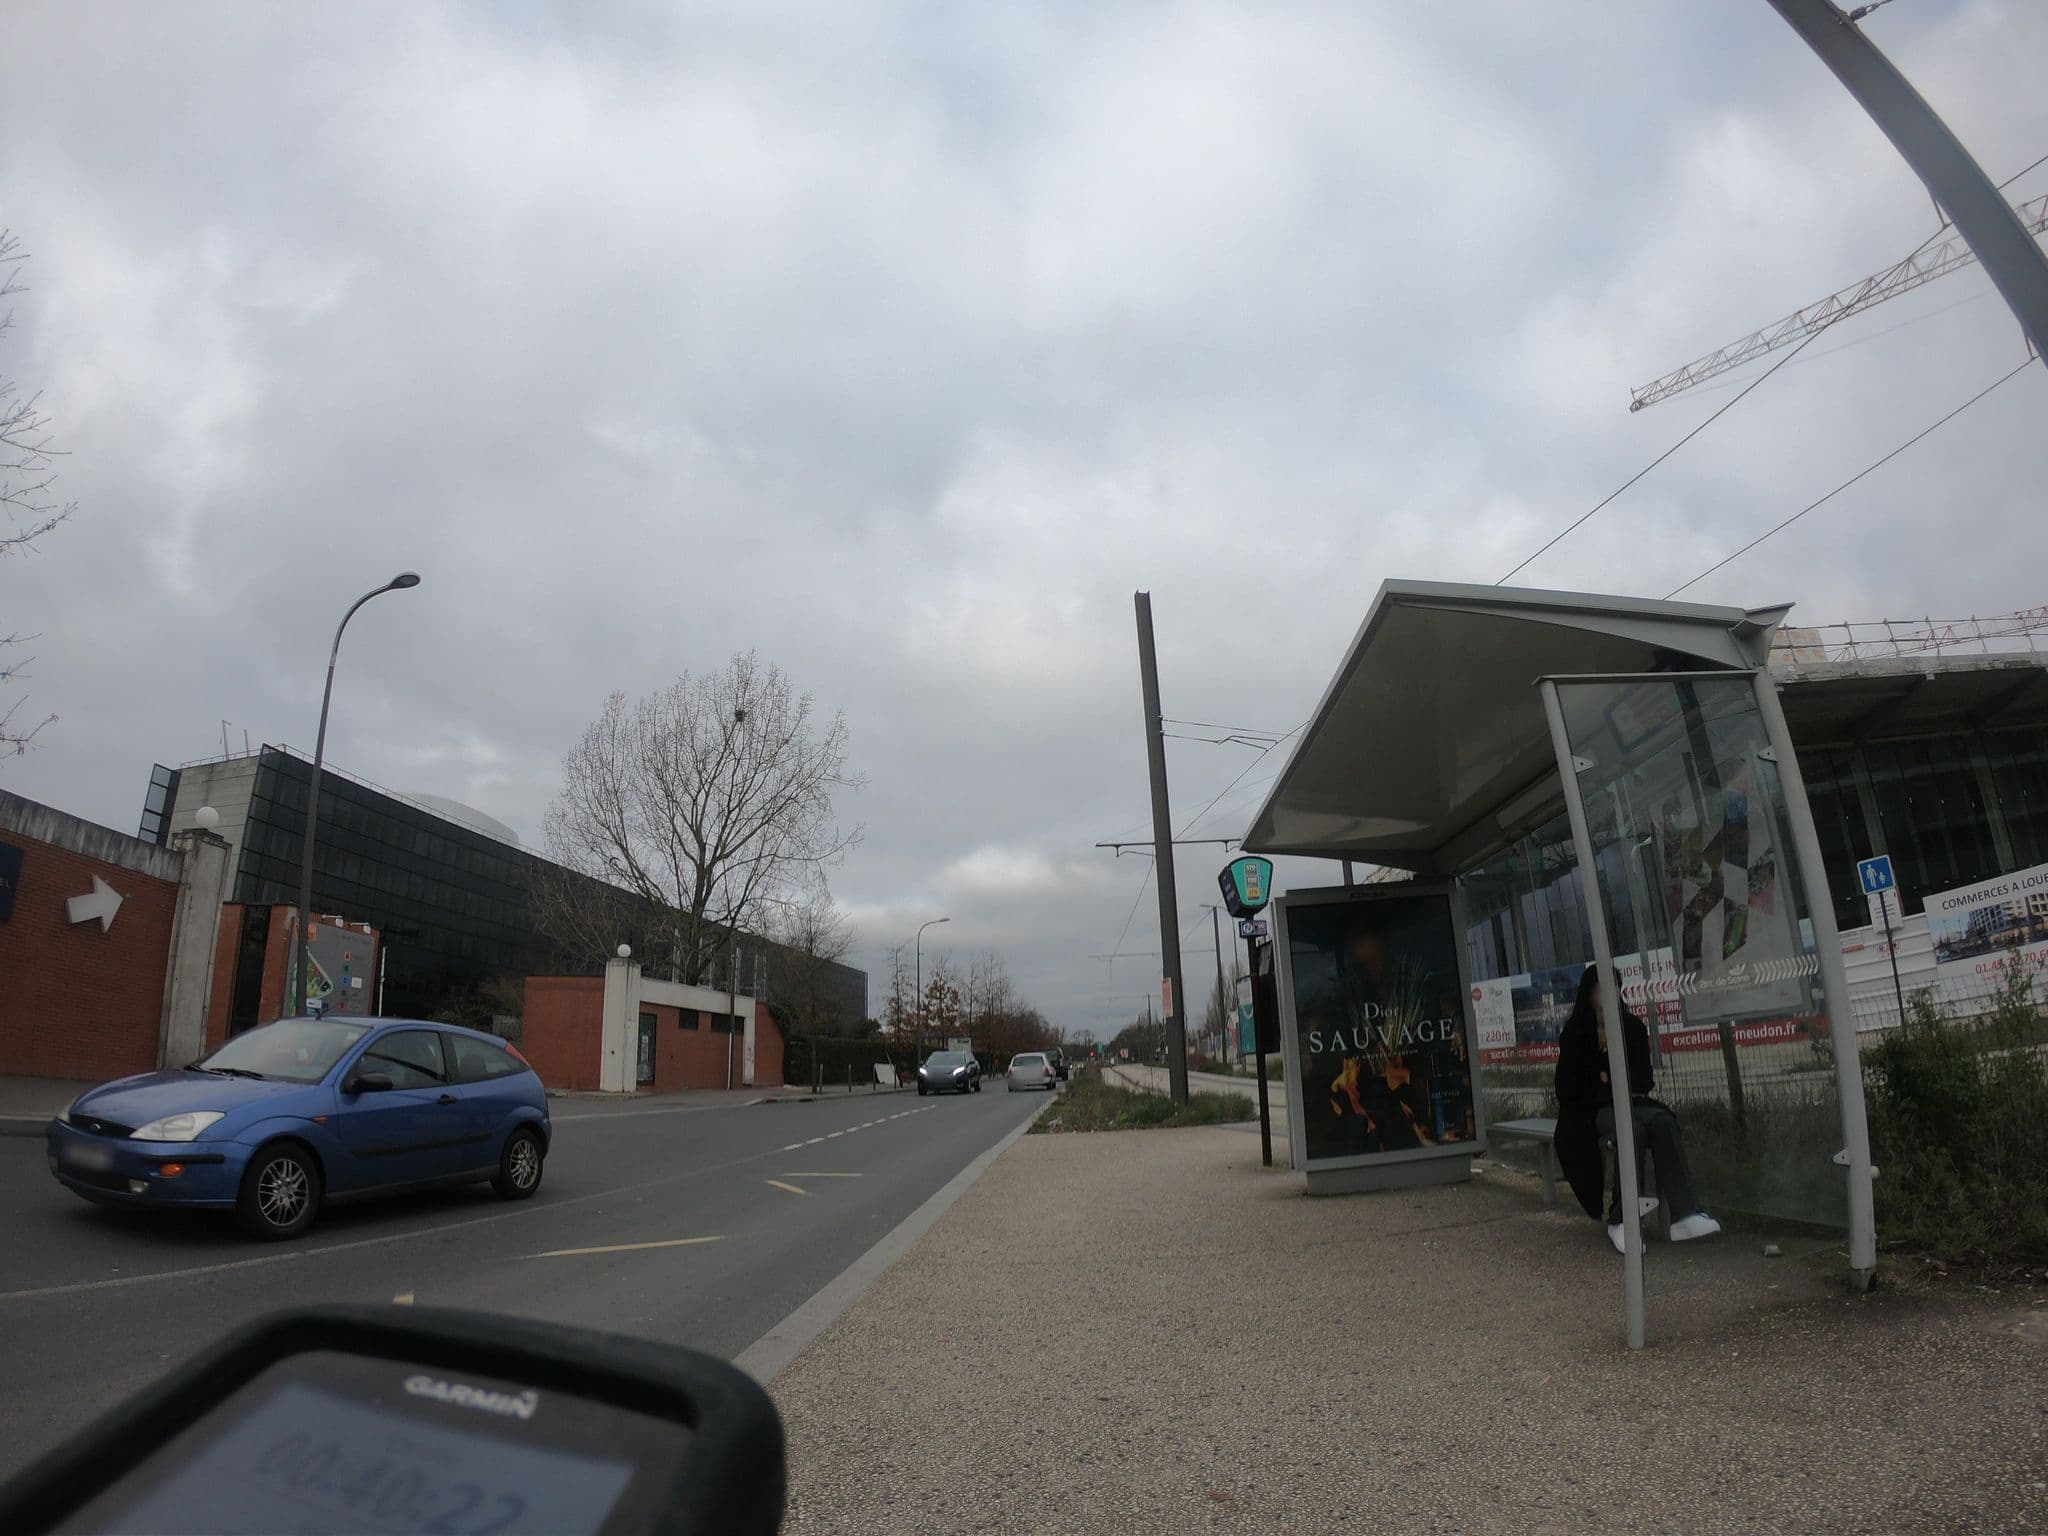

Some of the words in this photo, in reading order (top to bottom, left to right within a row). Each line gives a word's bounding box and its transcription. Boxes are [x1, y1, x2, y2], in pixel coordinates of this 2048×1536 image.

[1942, 884, 2009, 911] COMMERCES
[2012, 881, 2020, 892] A
[1364, 1002, 1399, 1019] Dior
[1309, 1018, 1455, 1053] SAUVAGE
[401, 1374, 537, 1419] GARMIN
